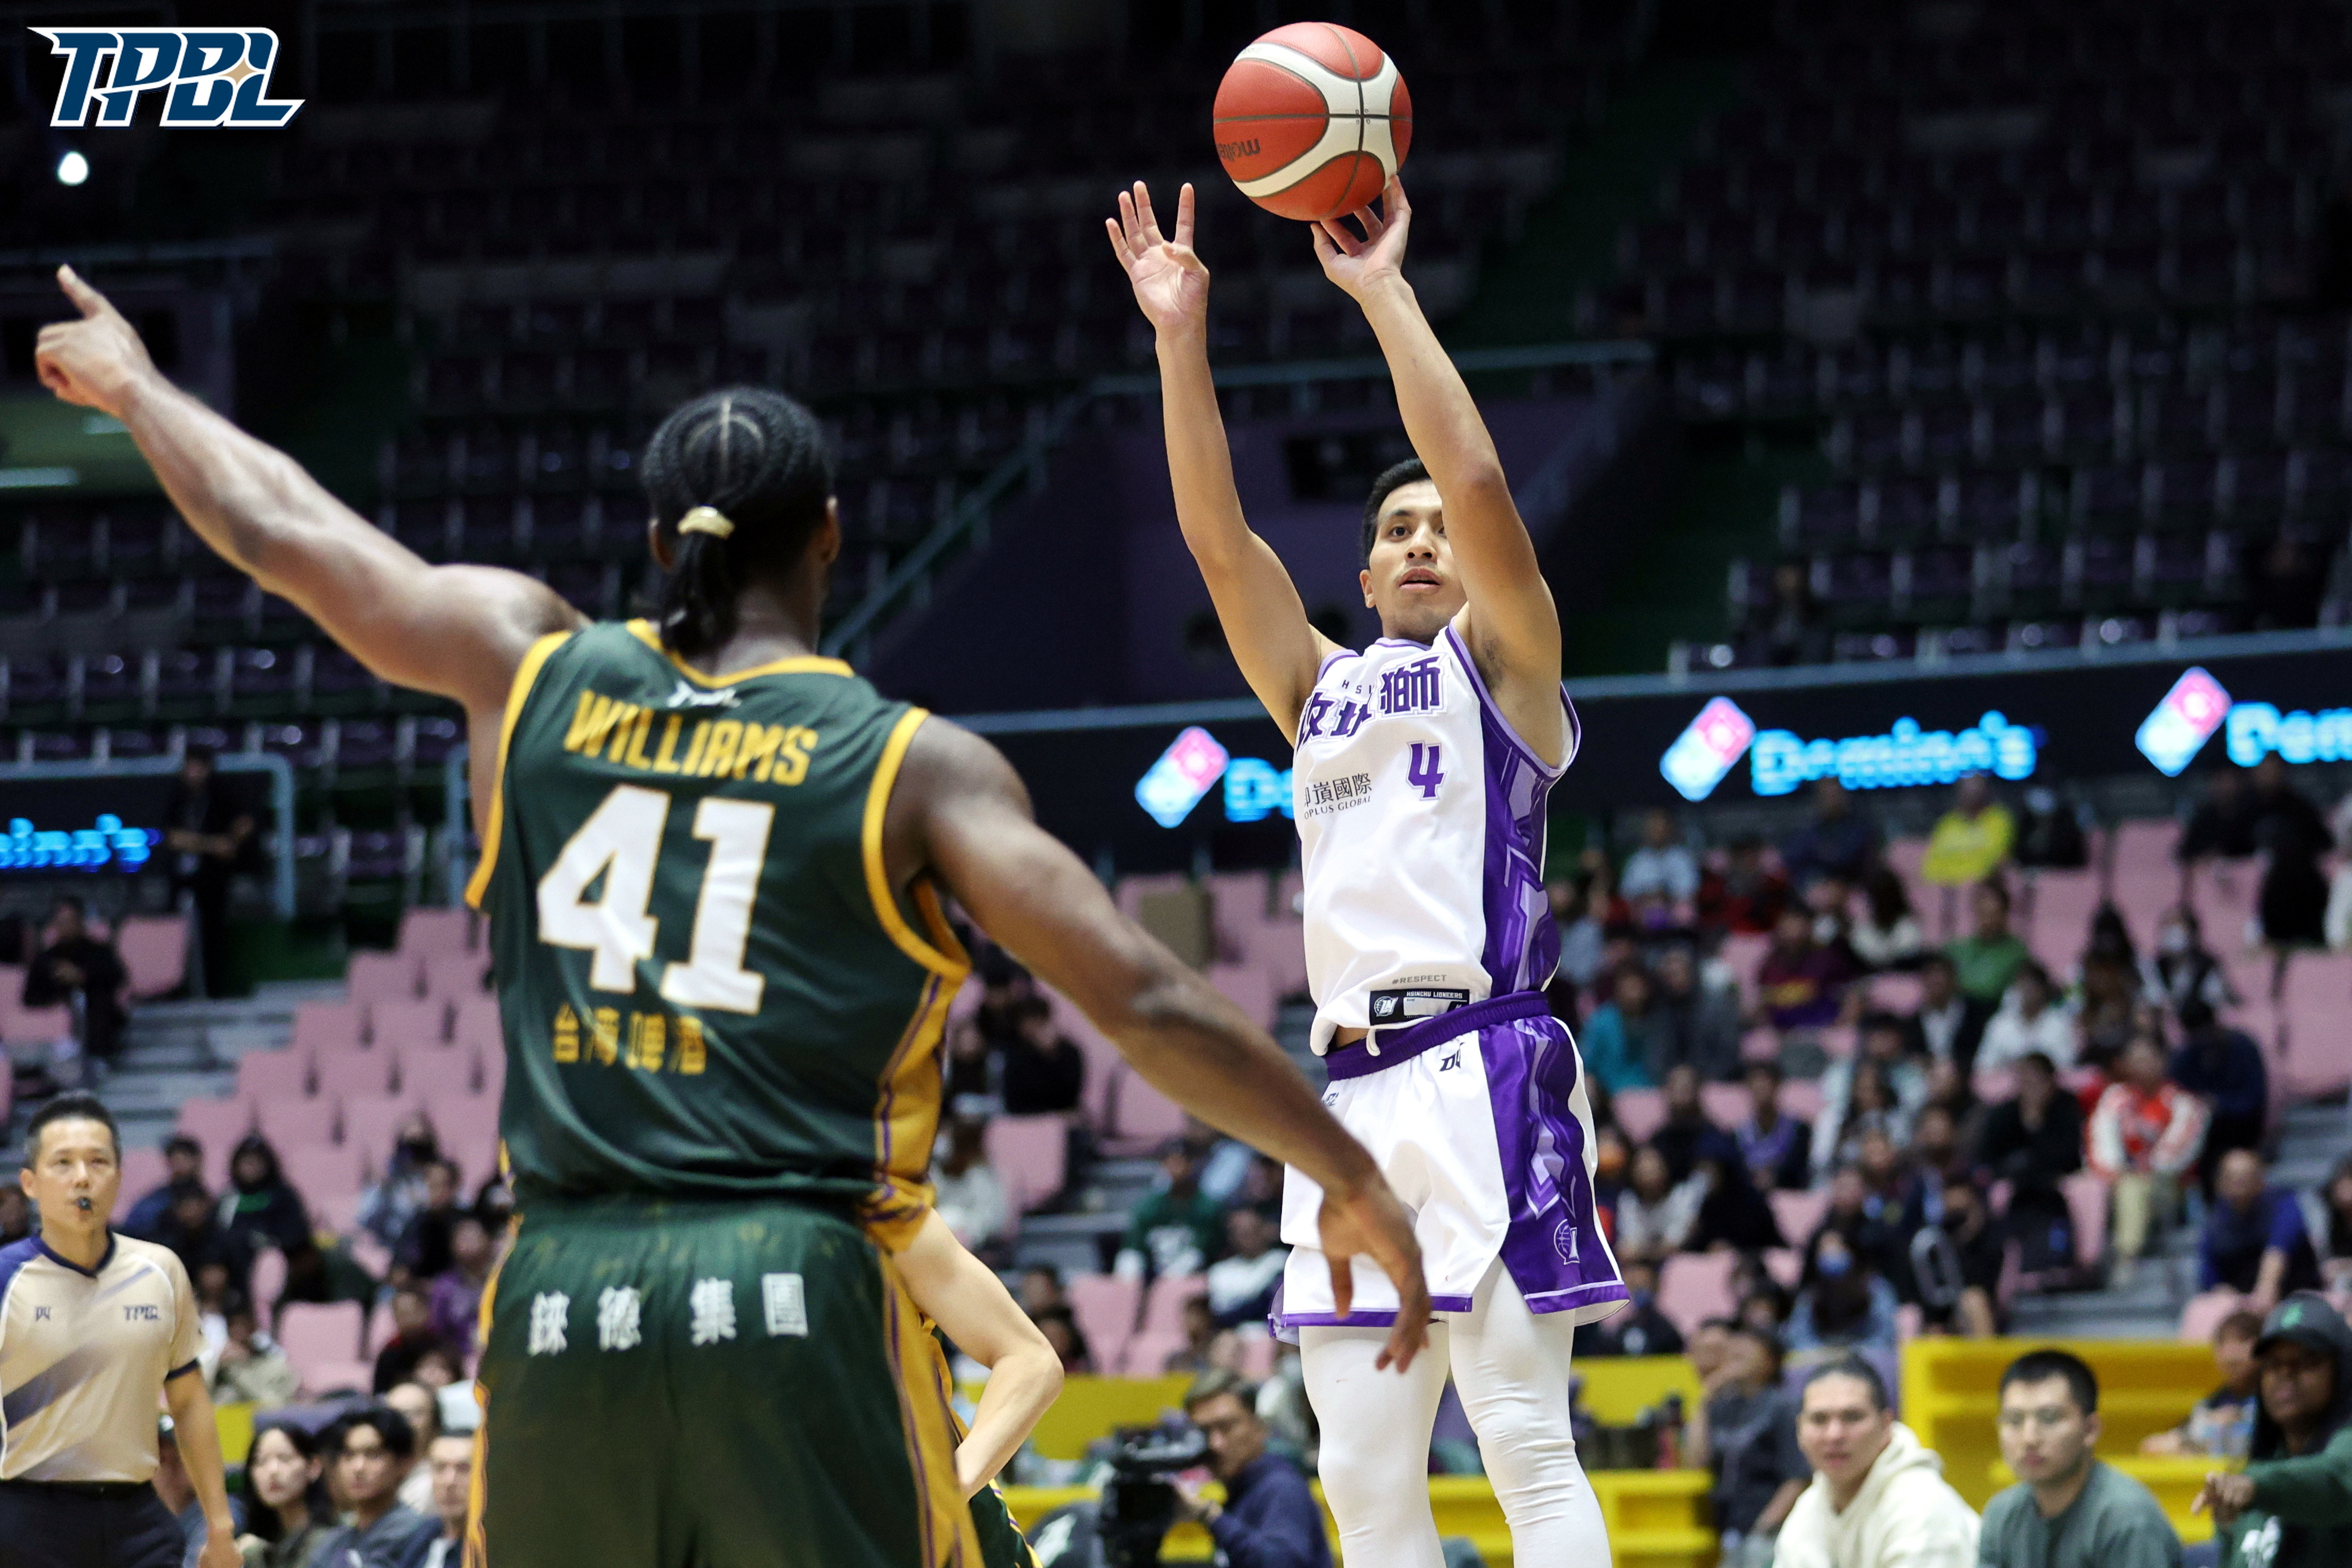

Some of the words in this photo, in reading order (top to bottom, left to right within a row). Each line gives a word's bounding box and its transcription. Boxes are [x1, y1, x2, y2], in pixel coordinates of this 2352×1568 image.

[563, 690, 819, 786] WILLIAMS
[1304, 773, 1372, 808] 嵿國際
[1407, 741, 1446, 799] 4
[1338, 795, 1371, 811] GLOBAL
[536, 783, 776, 1015] 41
[1392, 974, 1447, 985] #RESPECT
